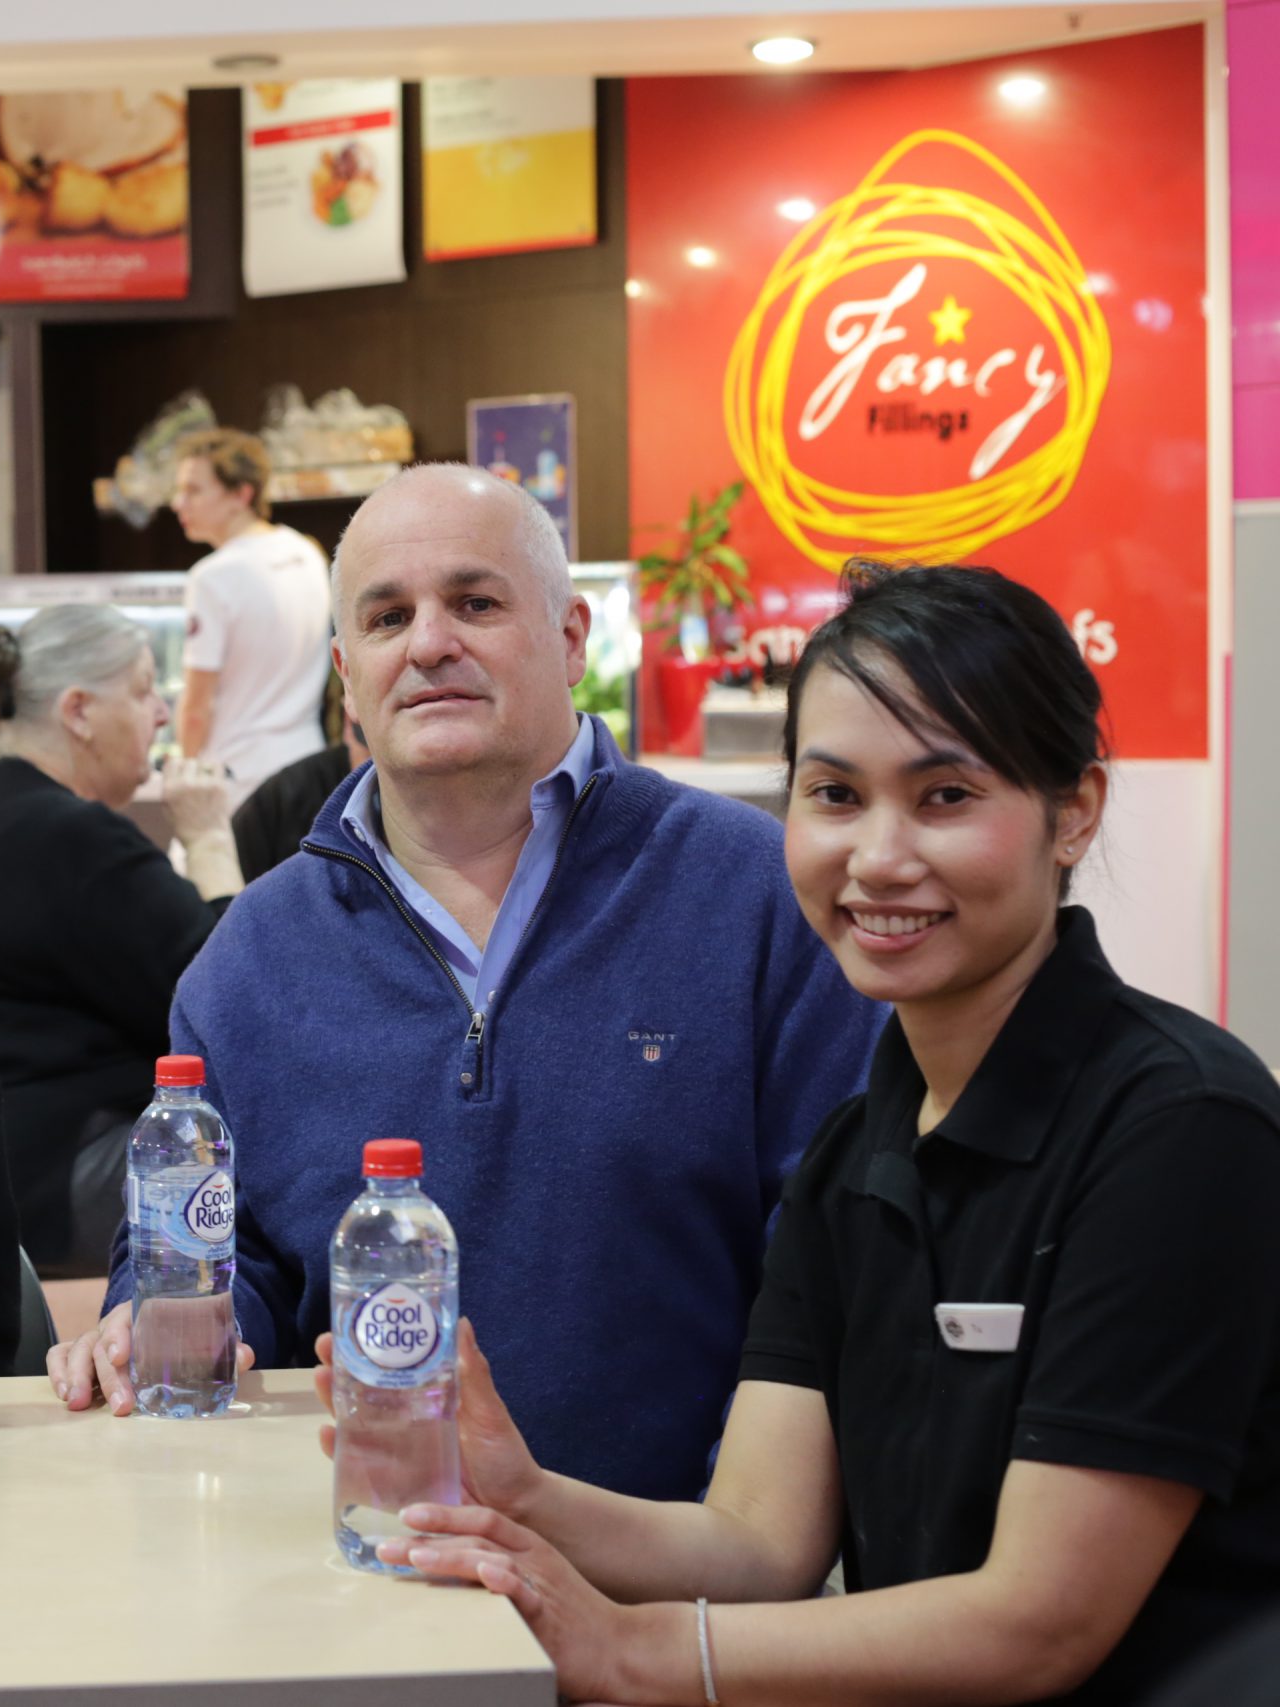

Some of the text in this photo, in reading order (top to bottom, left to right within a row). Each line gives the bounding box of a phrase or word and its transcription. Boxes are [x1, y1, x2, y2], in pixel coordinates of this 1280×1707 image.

[799, 262, 1070, 481] Fancy
[868, 401, 969, 441] Fillings
[627, 1031, 677, 1041] GANT
[201, 1186, 232, 1208] Cool
[196, 1207, 234, 1229] Ridge
[371, 1303, 422, 1324] Cool
[365, 1322, 428, 1354] Ridge
